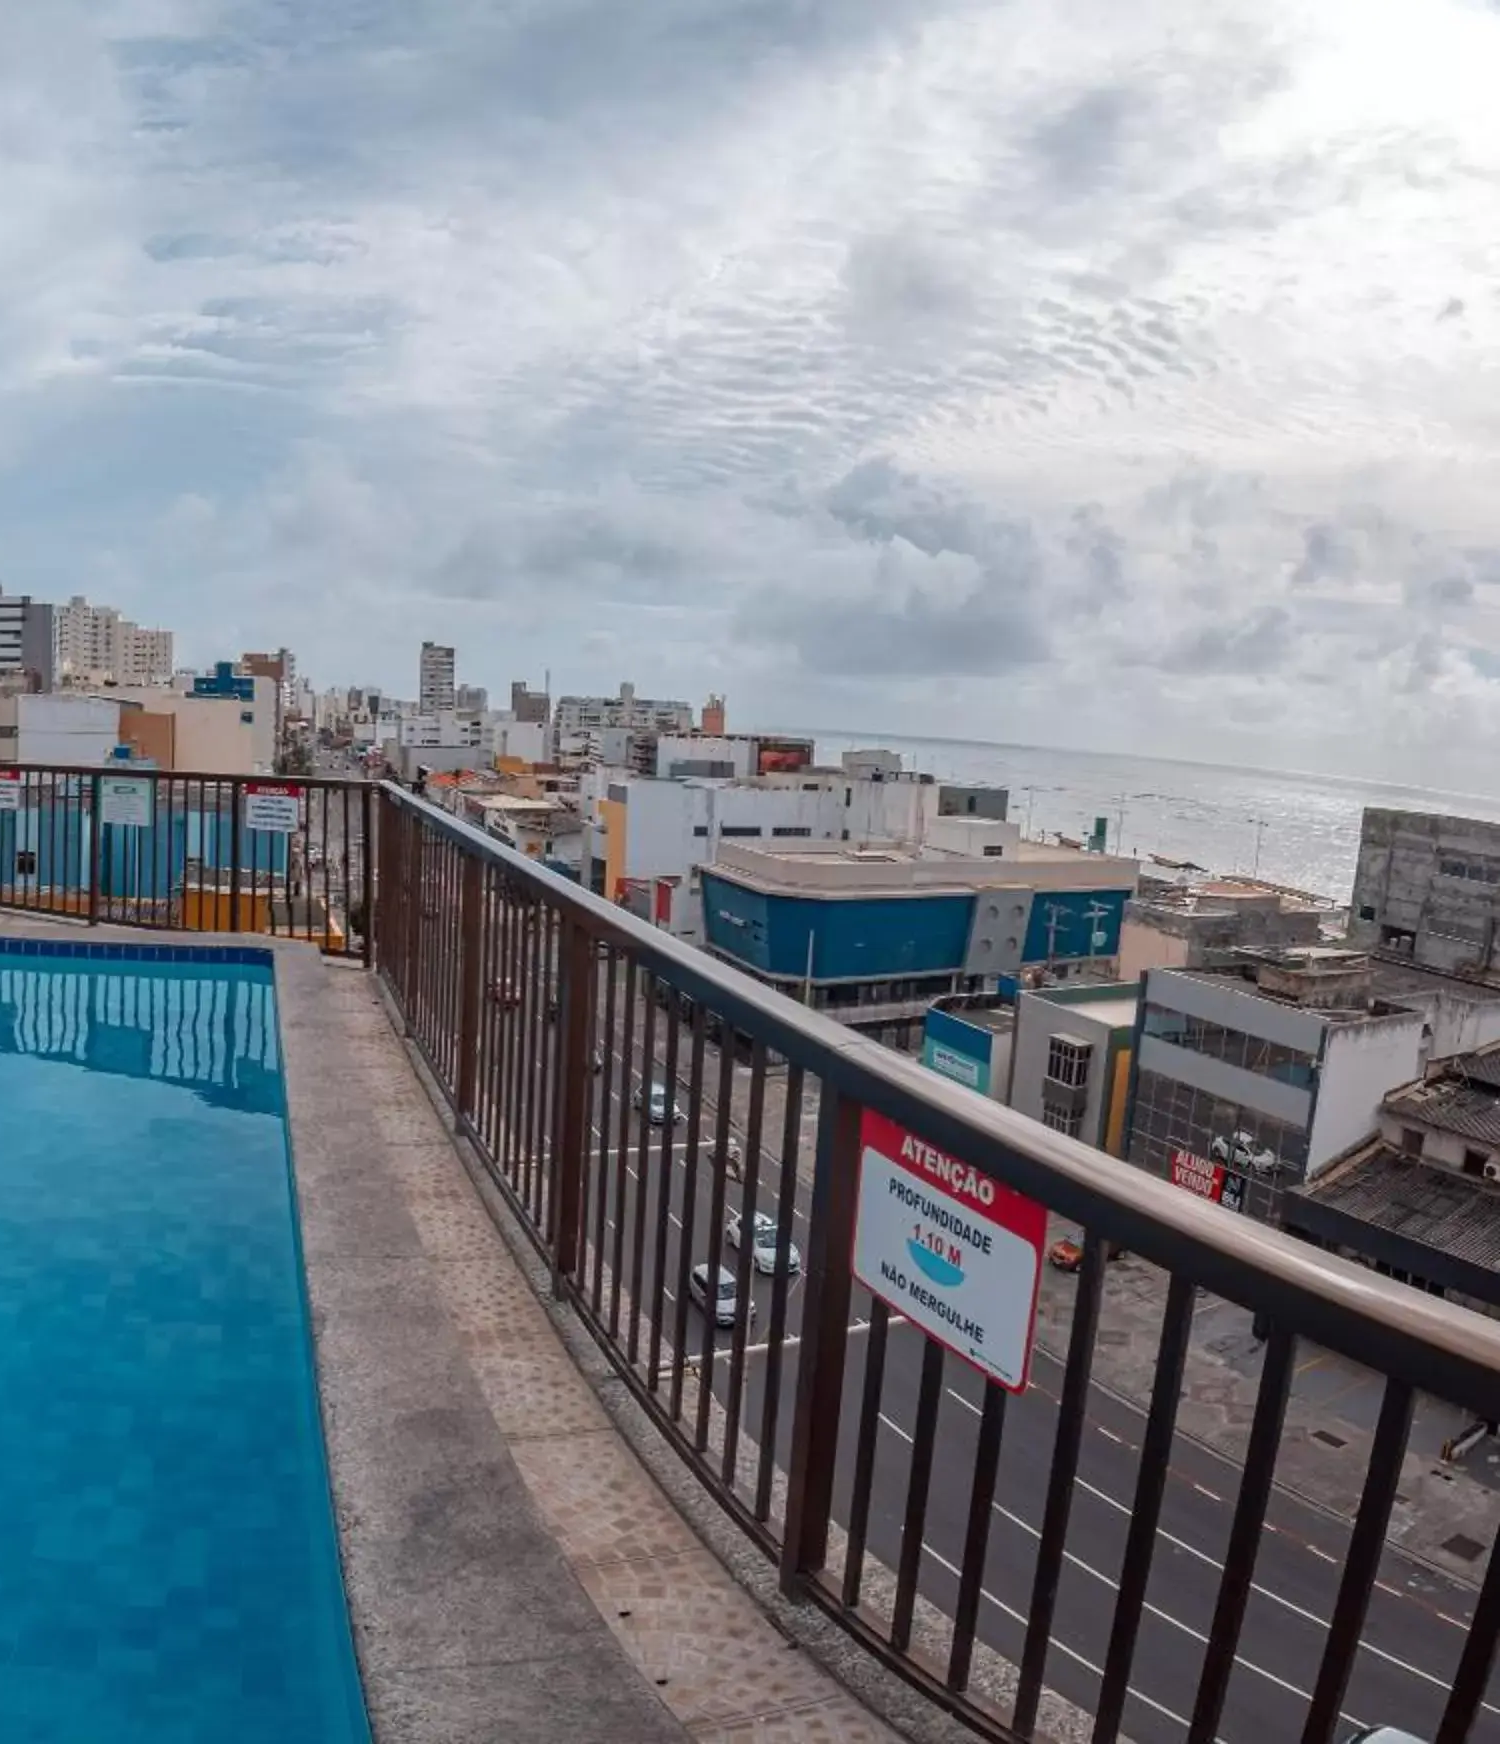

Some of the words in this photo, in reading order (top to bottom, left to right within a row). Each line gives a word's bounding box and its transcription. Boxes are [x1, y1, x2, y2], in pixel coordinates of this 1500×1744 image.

[901, 1135, 995, 1206] ATENÇÃO
[1175, 1165, 1212, 1197] VENDO
[1176, 1150, 1214, 1178] ALUGO
[888, 1177, 992, 1256] PROFUNDIDADE
[913, 1223, 944, 1252] 1.10
[947, 1249, 962, 1268] M
[880, 1260, 907, 1290] NÃO
[909, 1282, 985, 1344] MERGULHE
